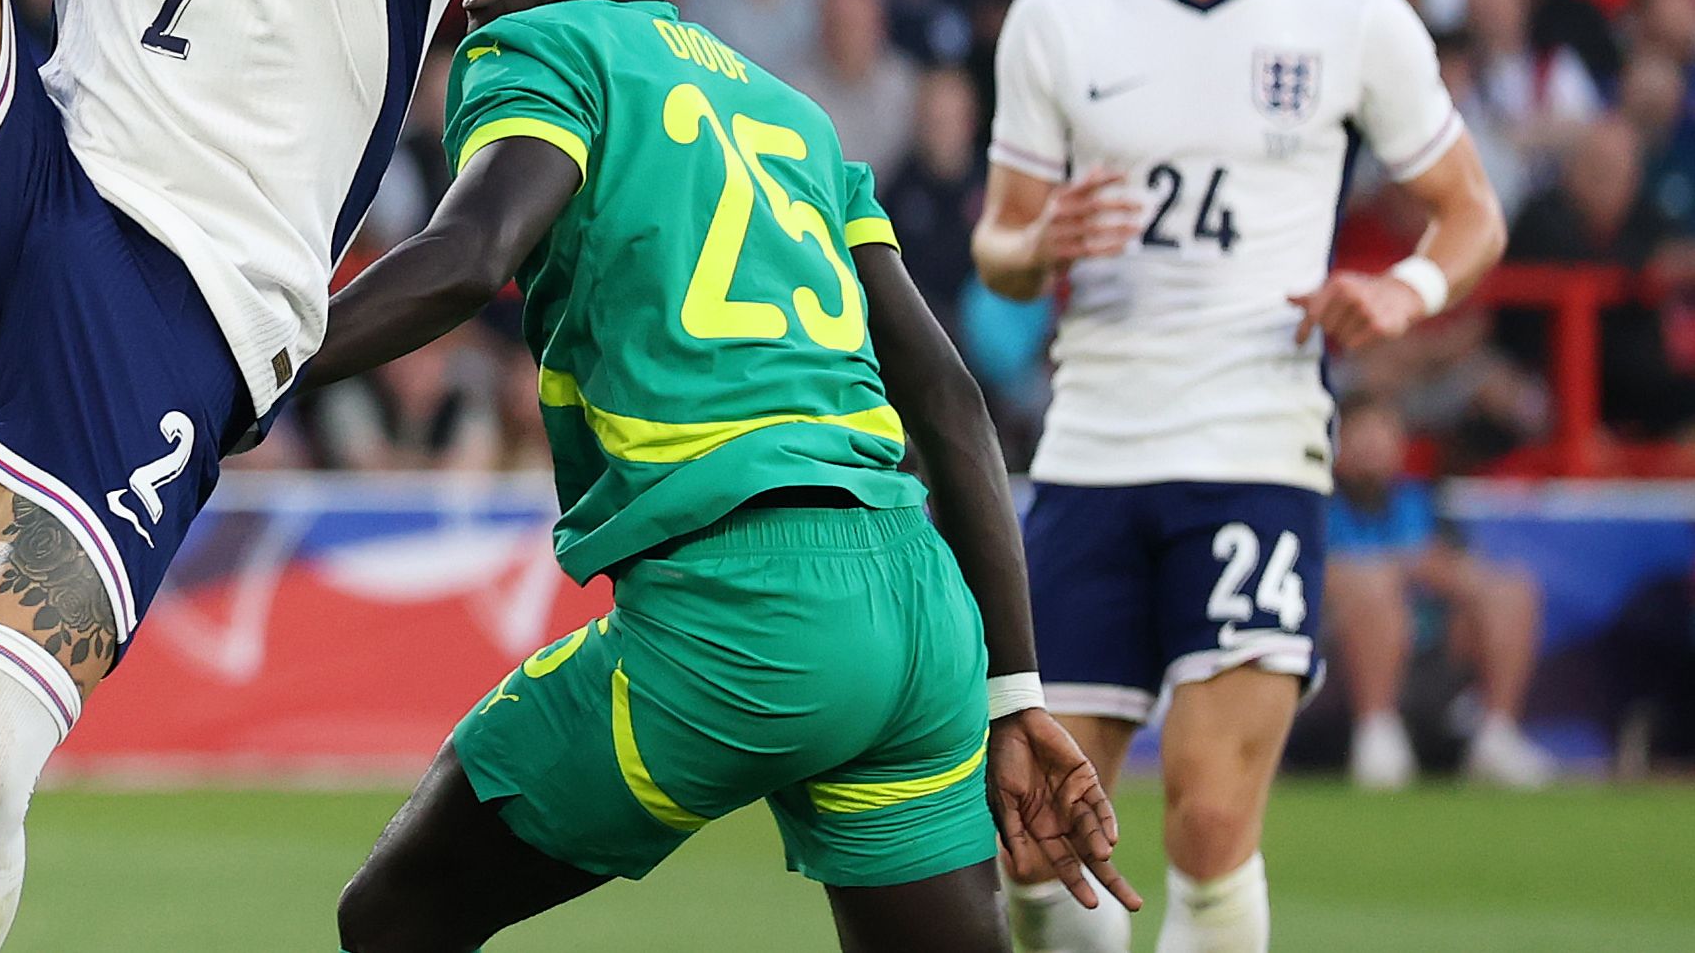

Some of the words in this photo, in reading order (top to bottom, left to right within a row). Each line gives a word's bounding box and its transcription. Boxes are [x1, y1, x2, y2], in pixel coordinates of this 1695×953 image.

[652, 18, 749, 84] DIOUF
[662, 83, 865, 352] 25
[1142, 164, 1242, 252] 24
[128, 410, 195, 525] 2
[1206, 521, 1307, 634] 24
